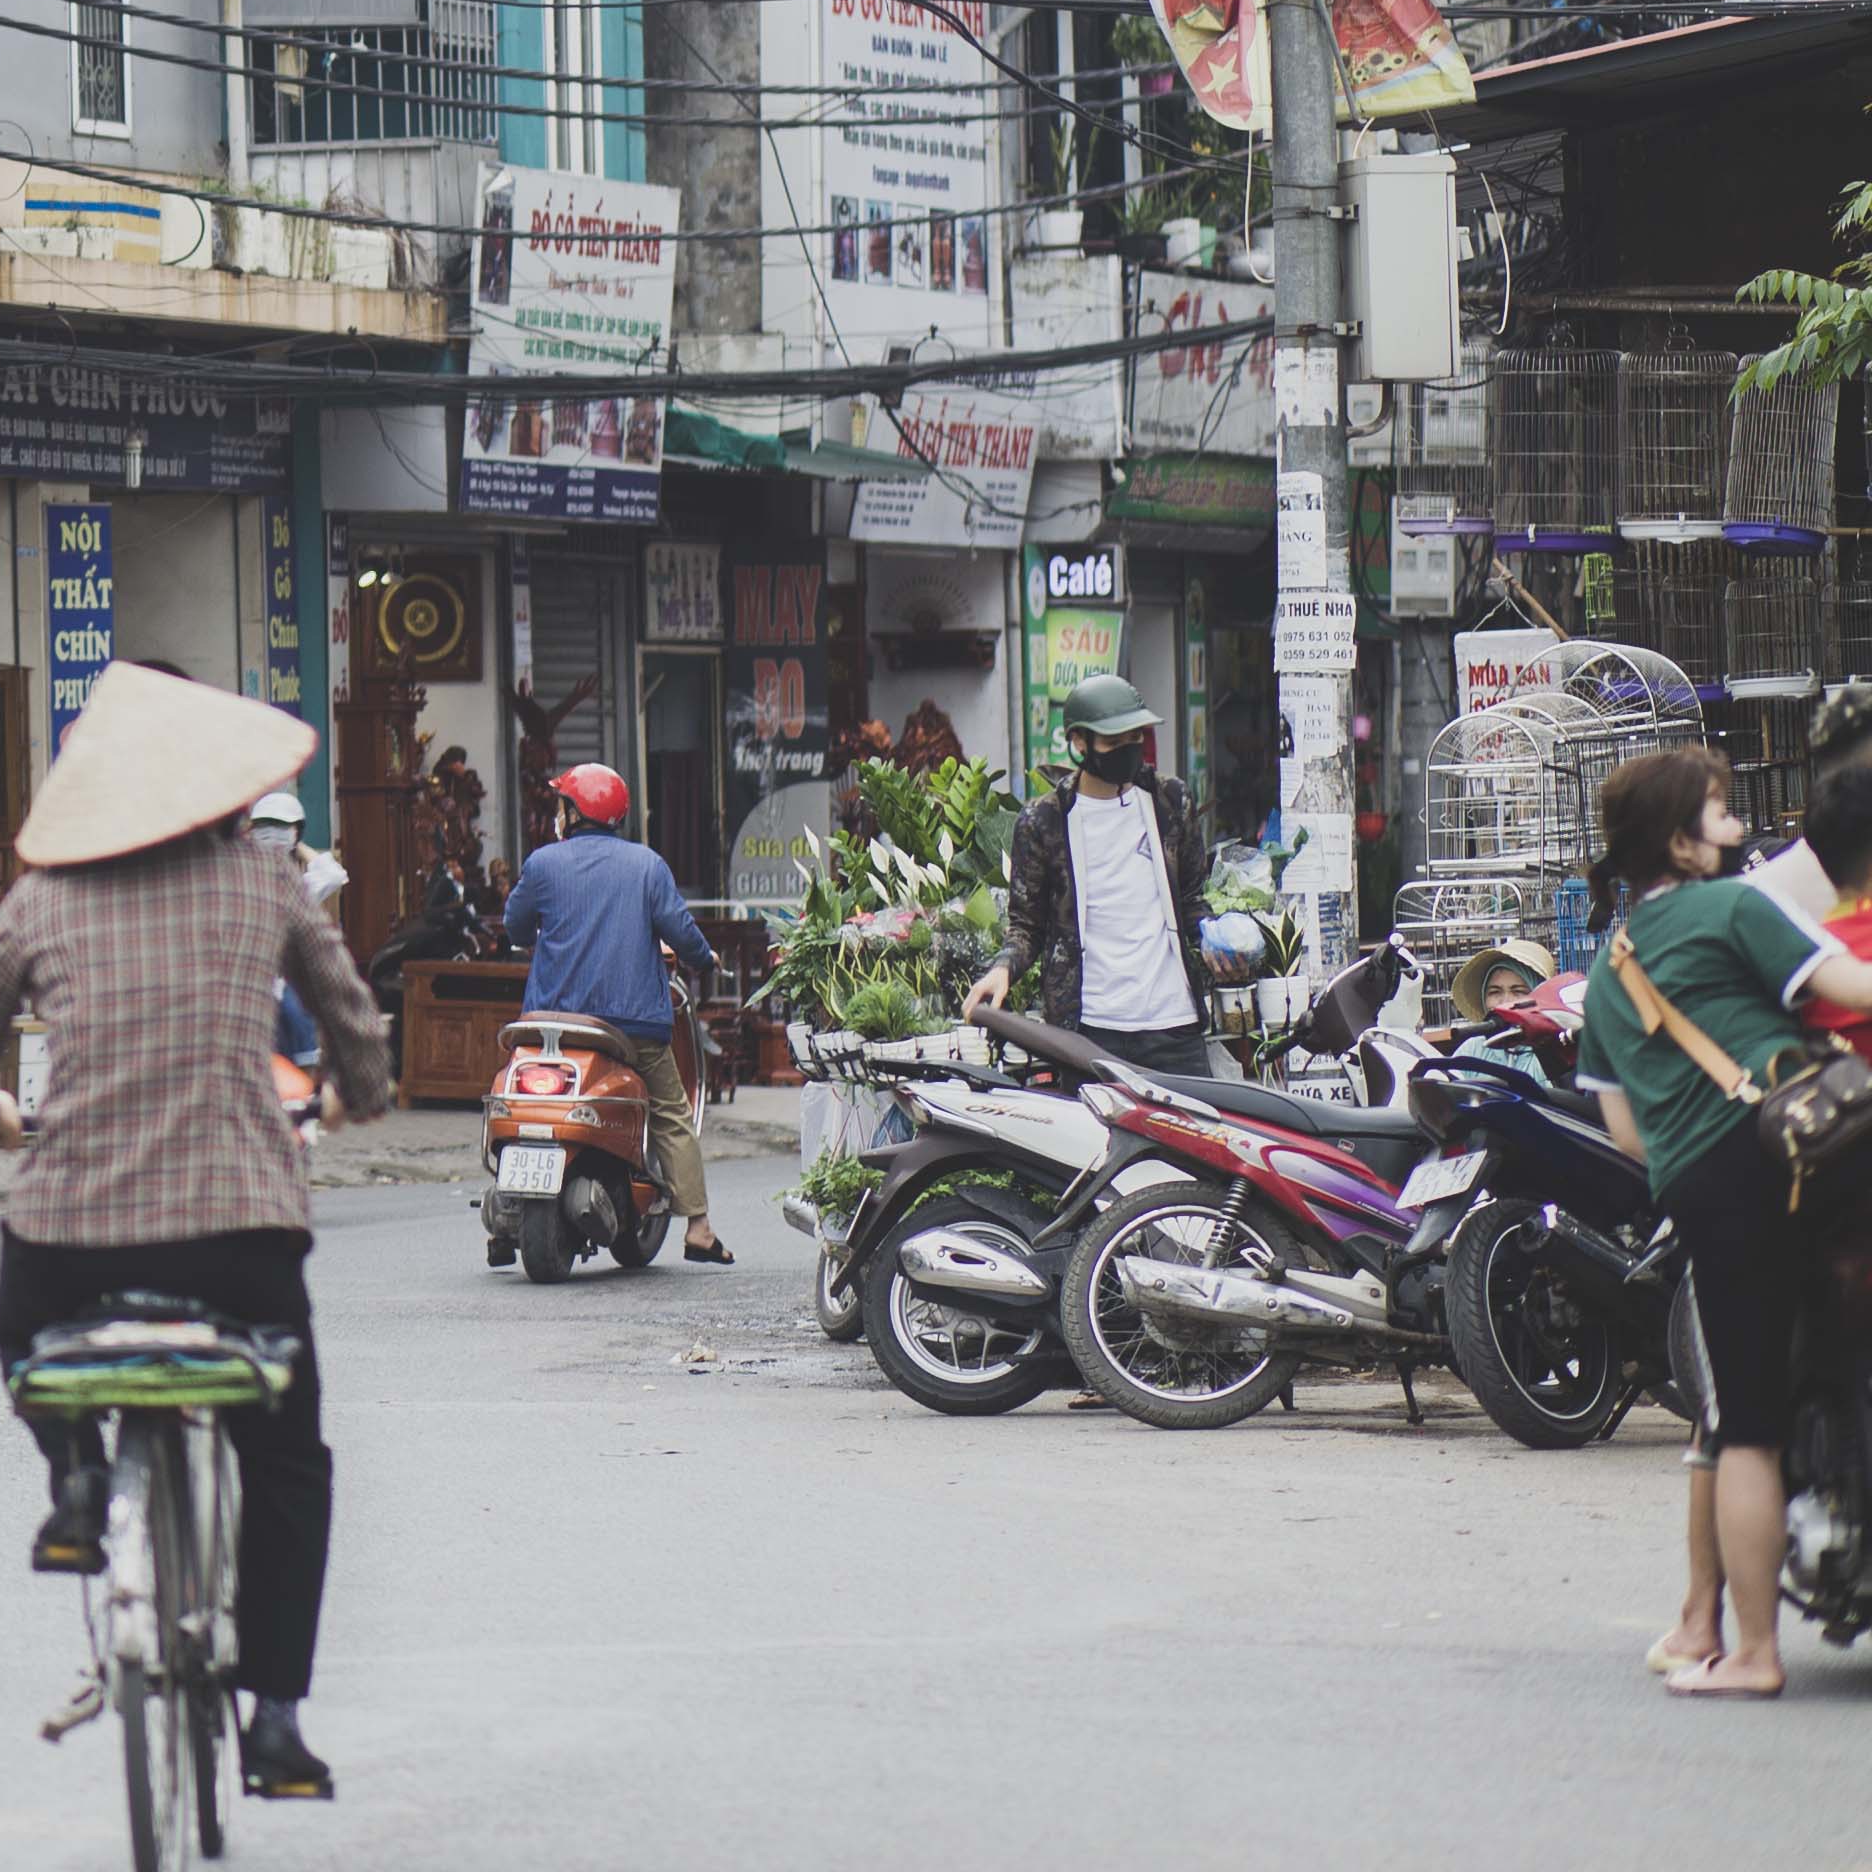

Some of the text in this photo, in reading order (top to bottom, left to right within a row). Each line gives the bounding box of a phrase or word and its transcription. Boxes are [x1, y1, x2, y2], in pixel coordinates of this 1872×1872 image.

[60, 512, 102, 560] NỘI
[273, 506, 290, 549] Đồ
[51, 564, 112, 609] THẤT
[274, 559, 292, 600] Gỗ
[1049, 554, 1113, 597] Café
[735, 565, 822, 646] MAY
[55, 622, 111, 662] CHÍN
[270, 615, 299, 649] Chín
[1309, 630, 1329, 642] 631
[1334, 630, 1351, 642] 052
[1309, 649, 1330, 660] 529
[1334, 649, 1354, 660] 461
[775, 749, 825, 777] trang
[1330, 1086, 1352, 1101] XE
[508, 1172, 553, 1190] 2350
